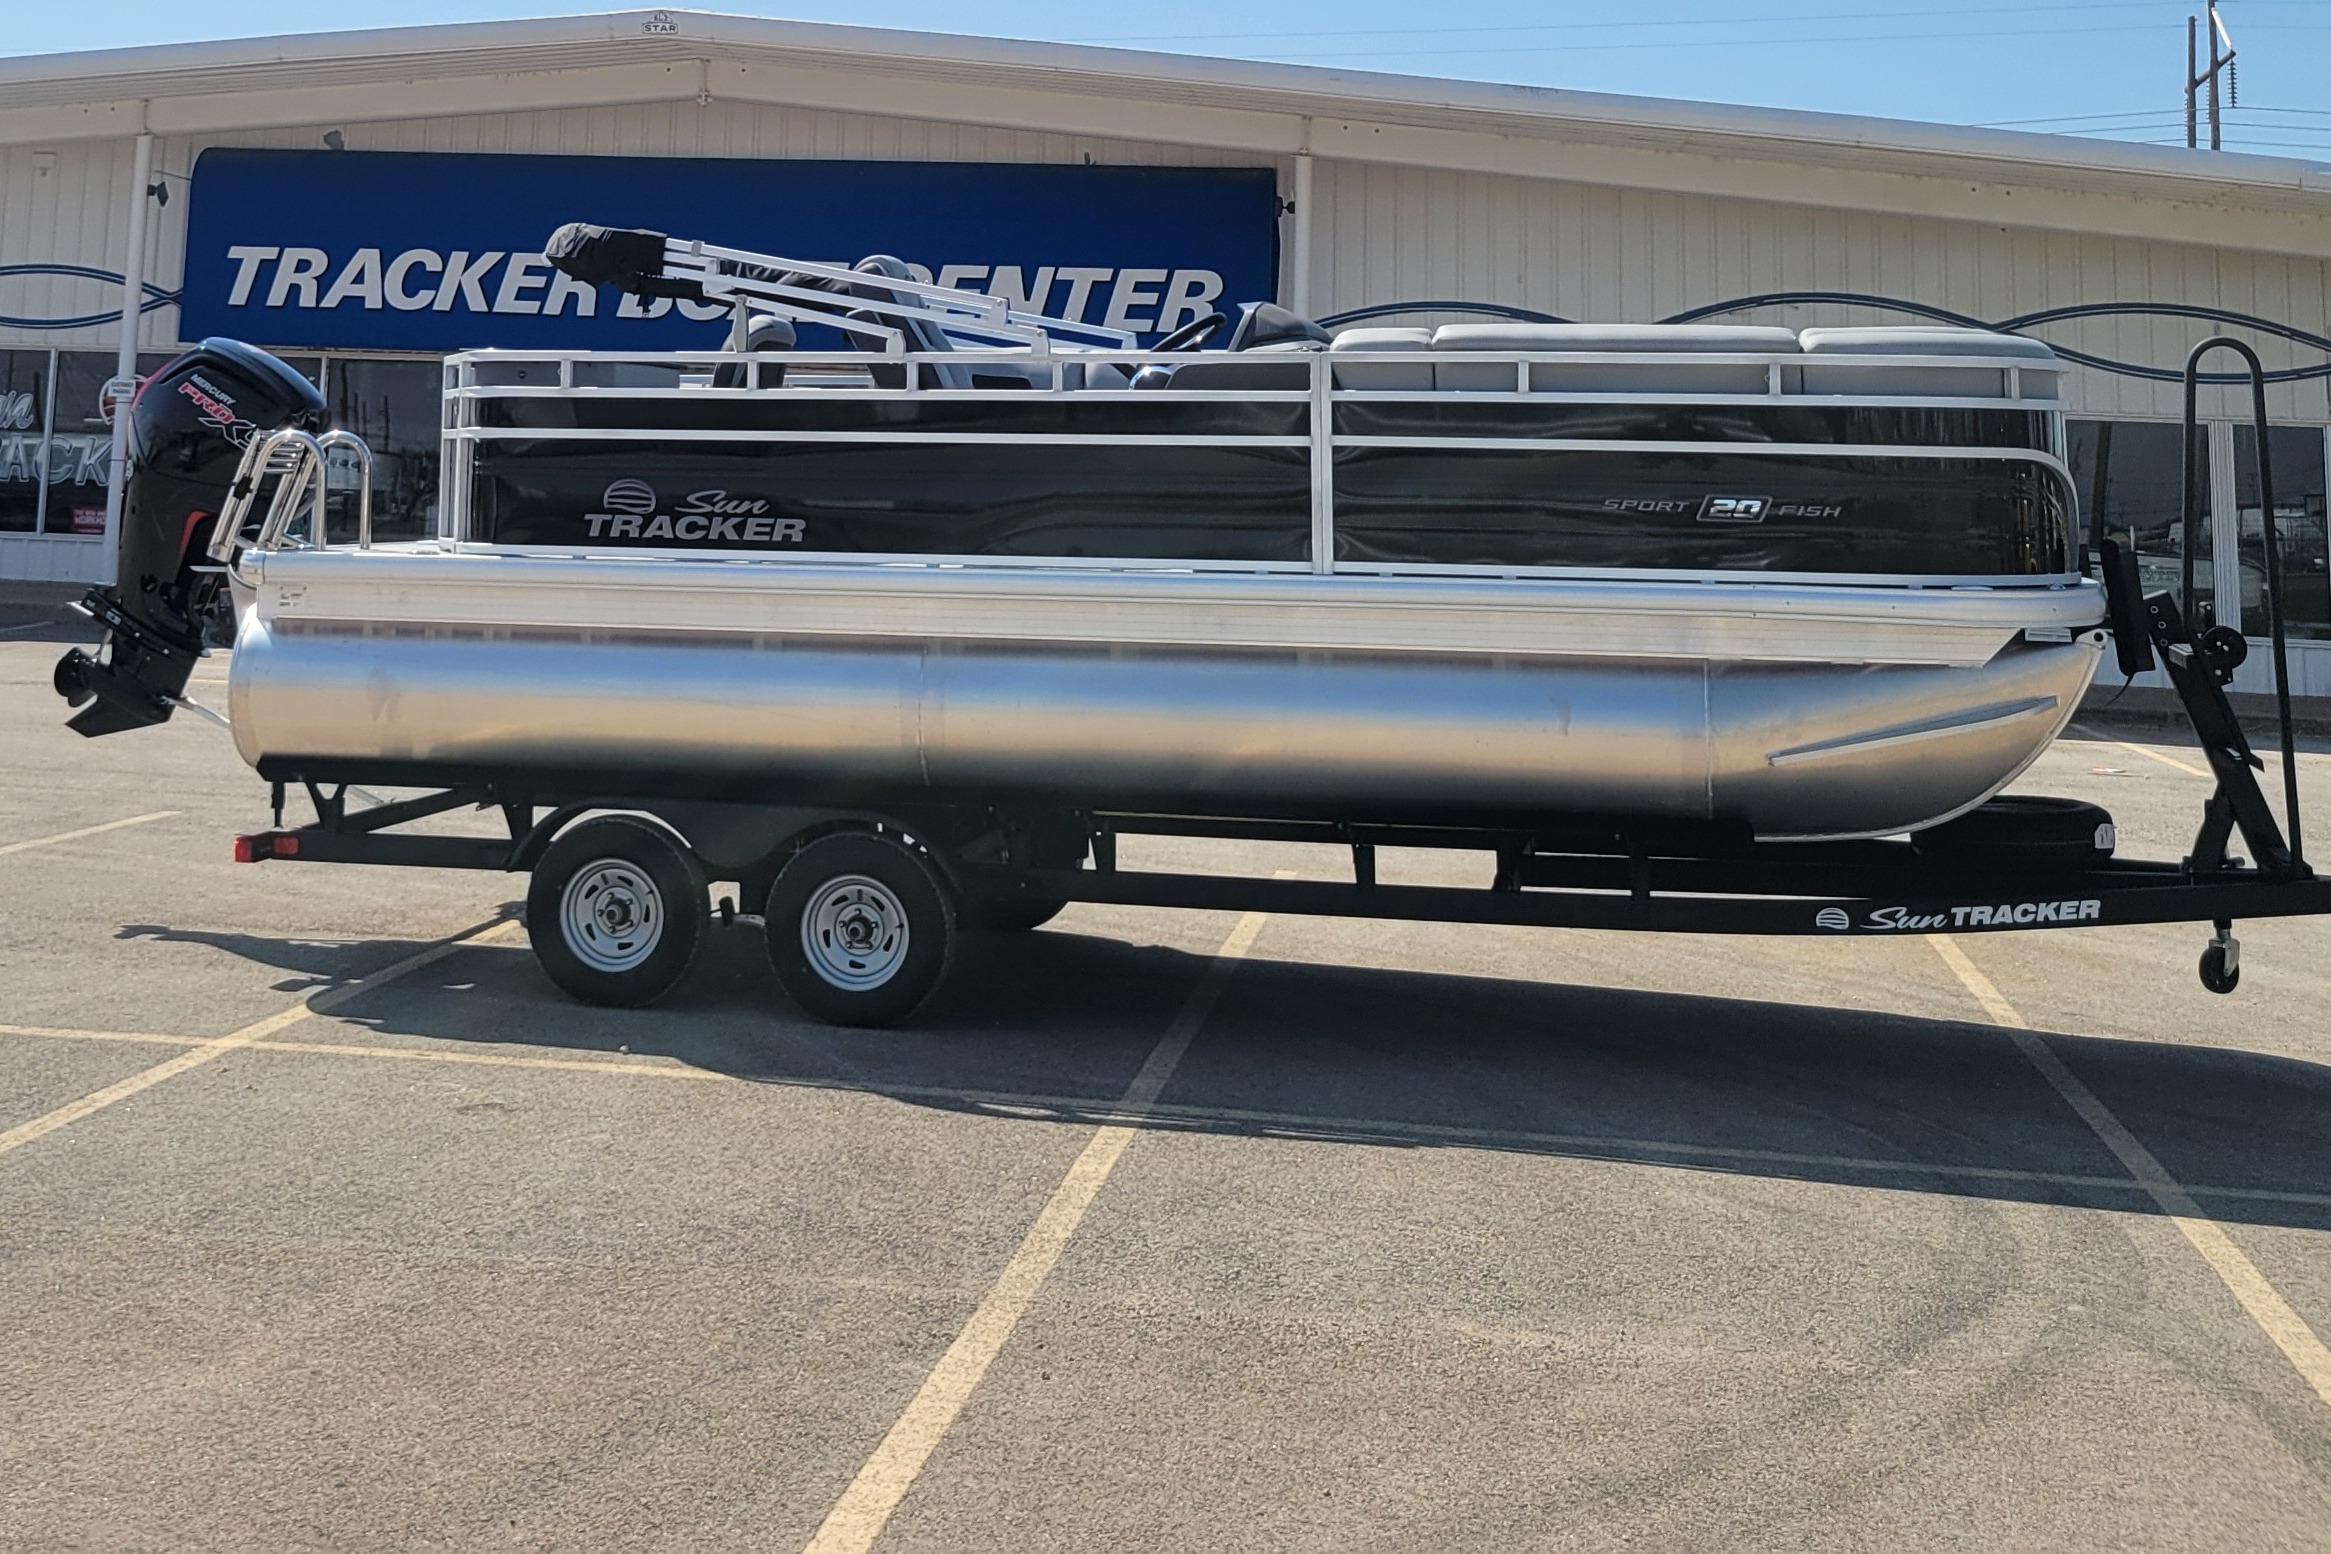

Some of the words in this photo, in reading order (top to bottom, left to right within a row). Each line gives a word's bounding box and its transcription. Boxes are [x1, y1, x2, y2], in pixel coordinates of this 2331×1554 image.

[644, 24, 676, 32] STAR
[900, 262, 1225, 334] ENTER
[177, 381, 236, 425] PRO
[190, 373, 237, 406] MERCURY
[675, 490, 770, 514] Sun
[1602, 499, 1690, 512] SPORT
[1710, 499, 1762, 519] 20
[1778, 504, 1842, 518] FISH
[583, 513, 807, 543] TRACKER
[1859, 906, 1949, 930] Sun
[1950, 899, 2101, 927] TRACKER
